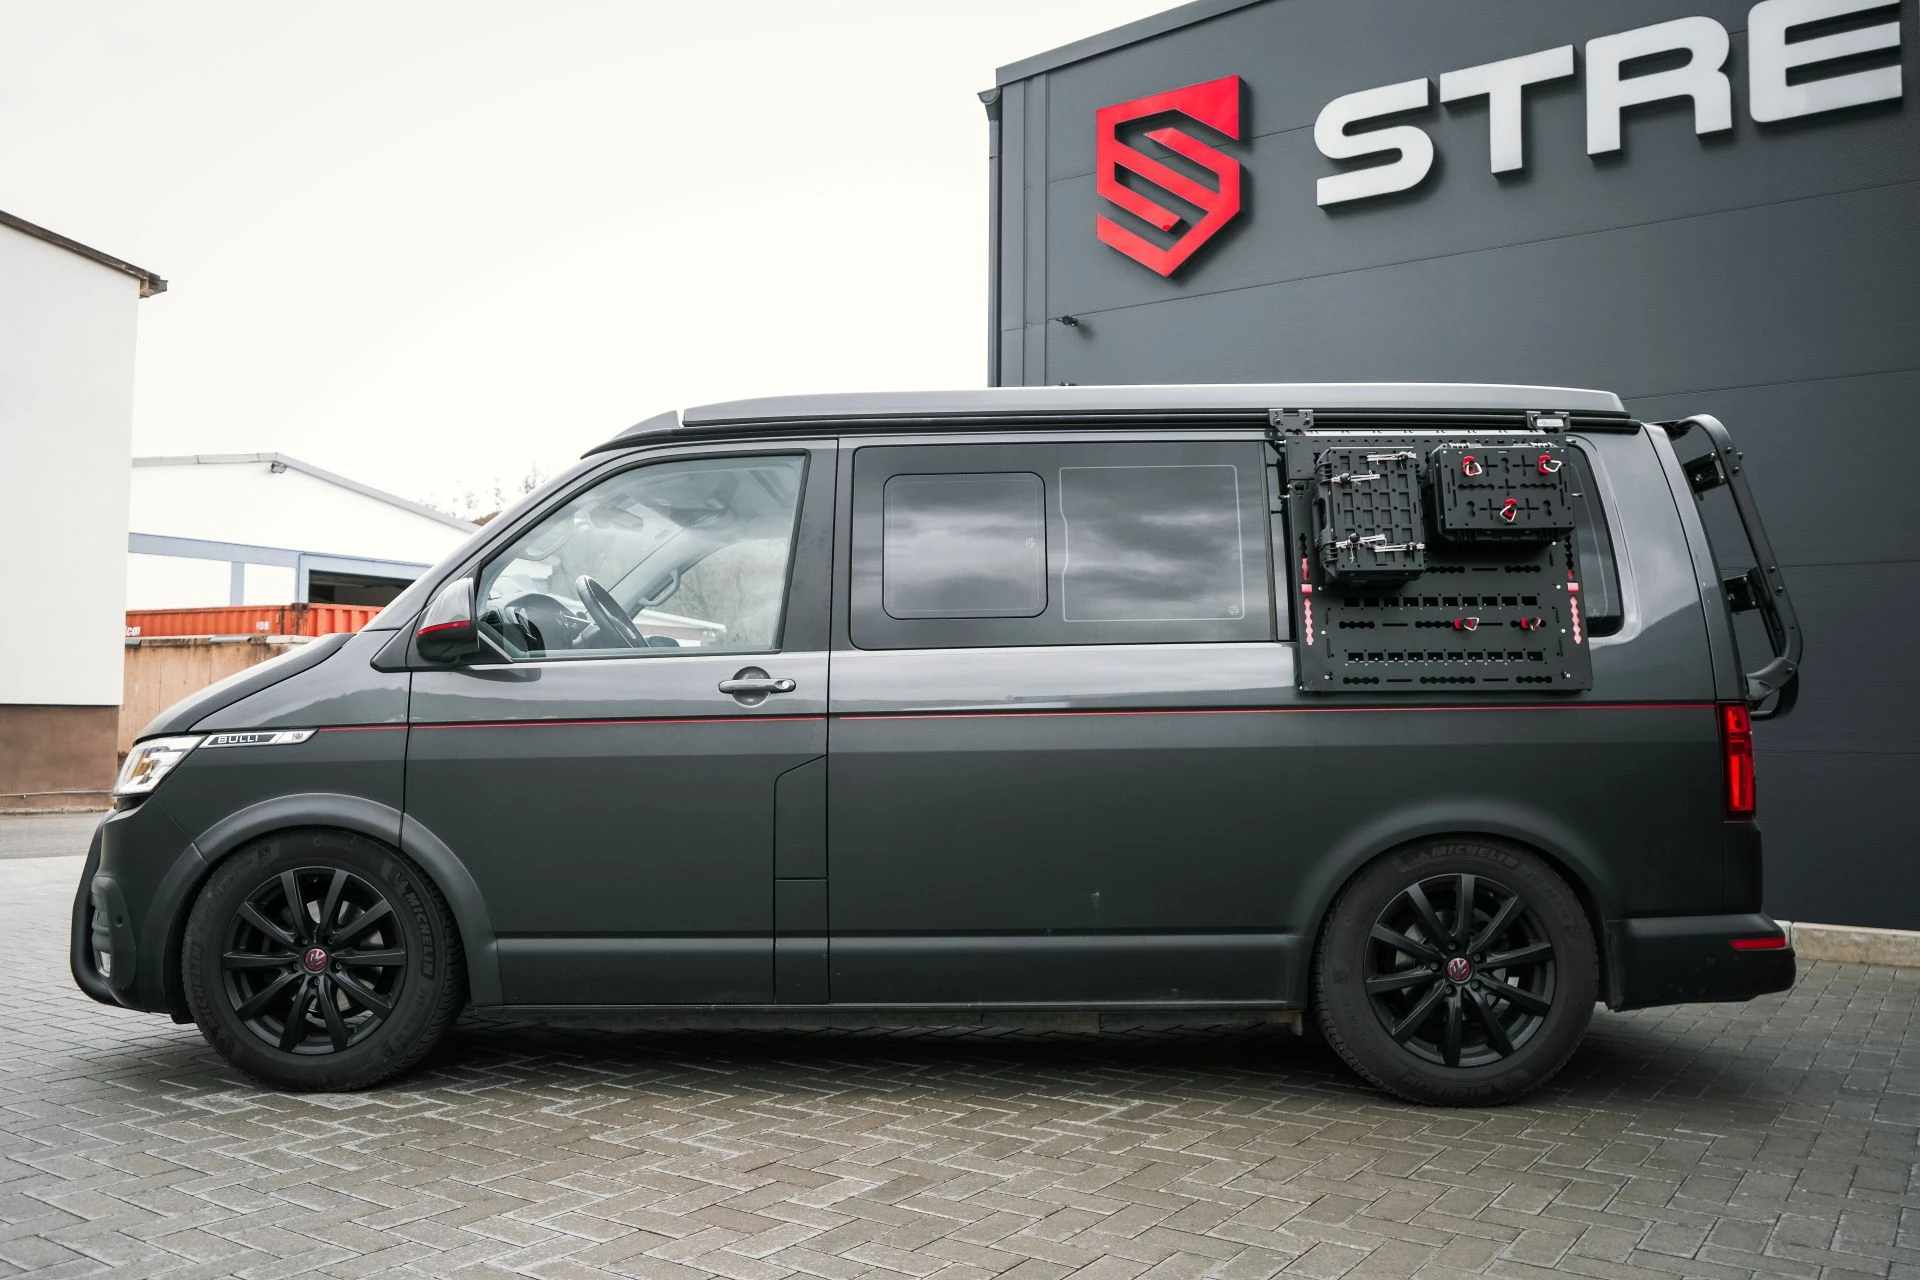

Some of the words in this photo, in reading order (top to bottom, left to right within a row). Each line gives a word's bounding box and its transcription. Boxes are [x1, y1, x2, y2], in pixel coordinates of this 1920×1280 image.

[1314, 0, 1902, 209] STRE
[217, 734, 259, 744] BULLI
[1430, 845, 1519, 867] MICHELIN
[406, 891, 435, 978] MICHELIN
